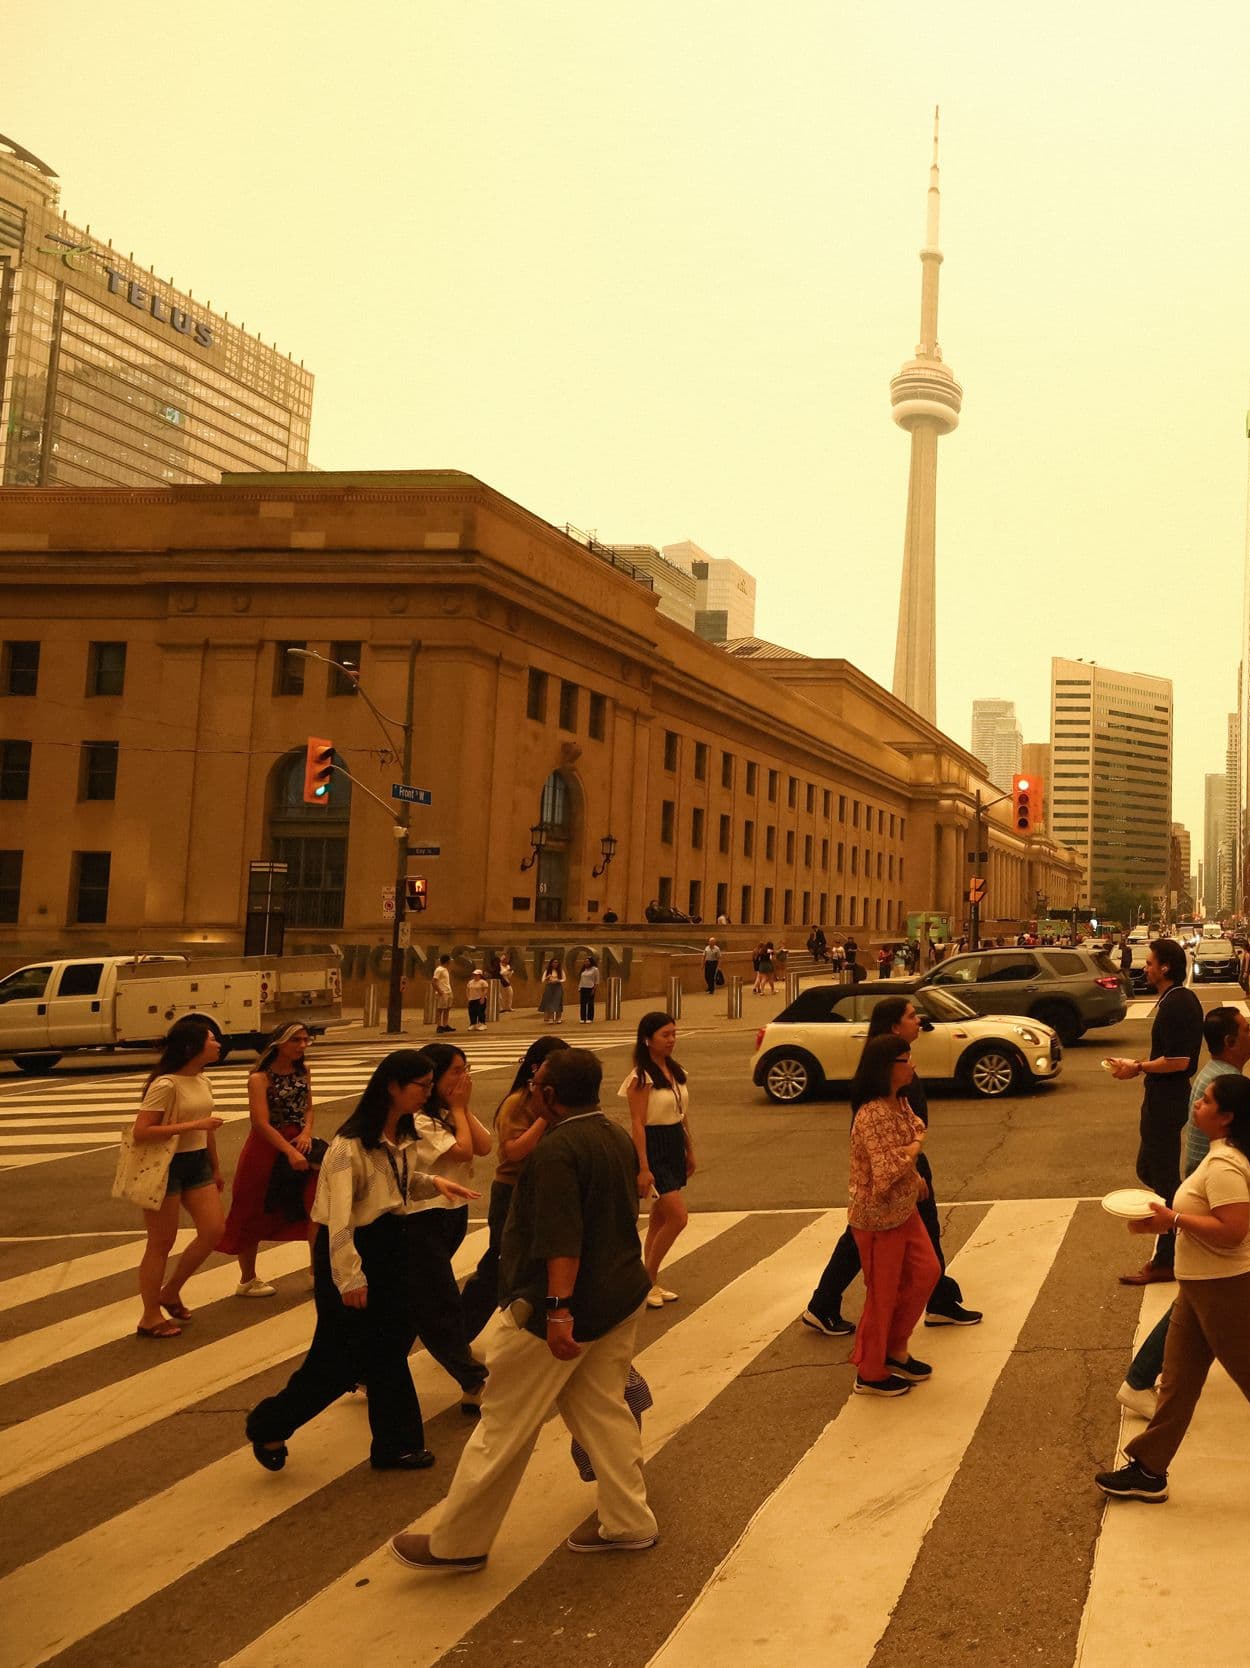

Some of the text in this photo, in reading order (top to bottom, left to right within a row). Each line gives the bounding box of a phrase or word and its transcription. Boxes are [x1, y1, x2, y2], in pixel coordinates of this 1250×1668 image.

[104, 266, 213, 348] TELUS
[399, 786, 414, 799] Front
[419, 791, 425, 801] W
[540, 882, 547, 893] 61
